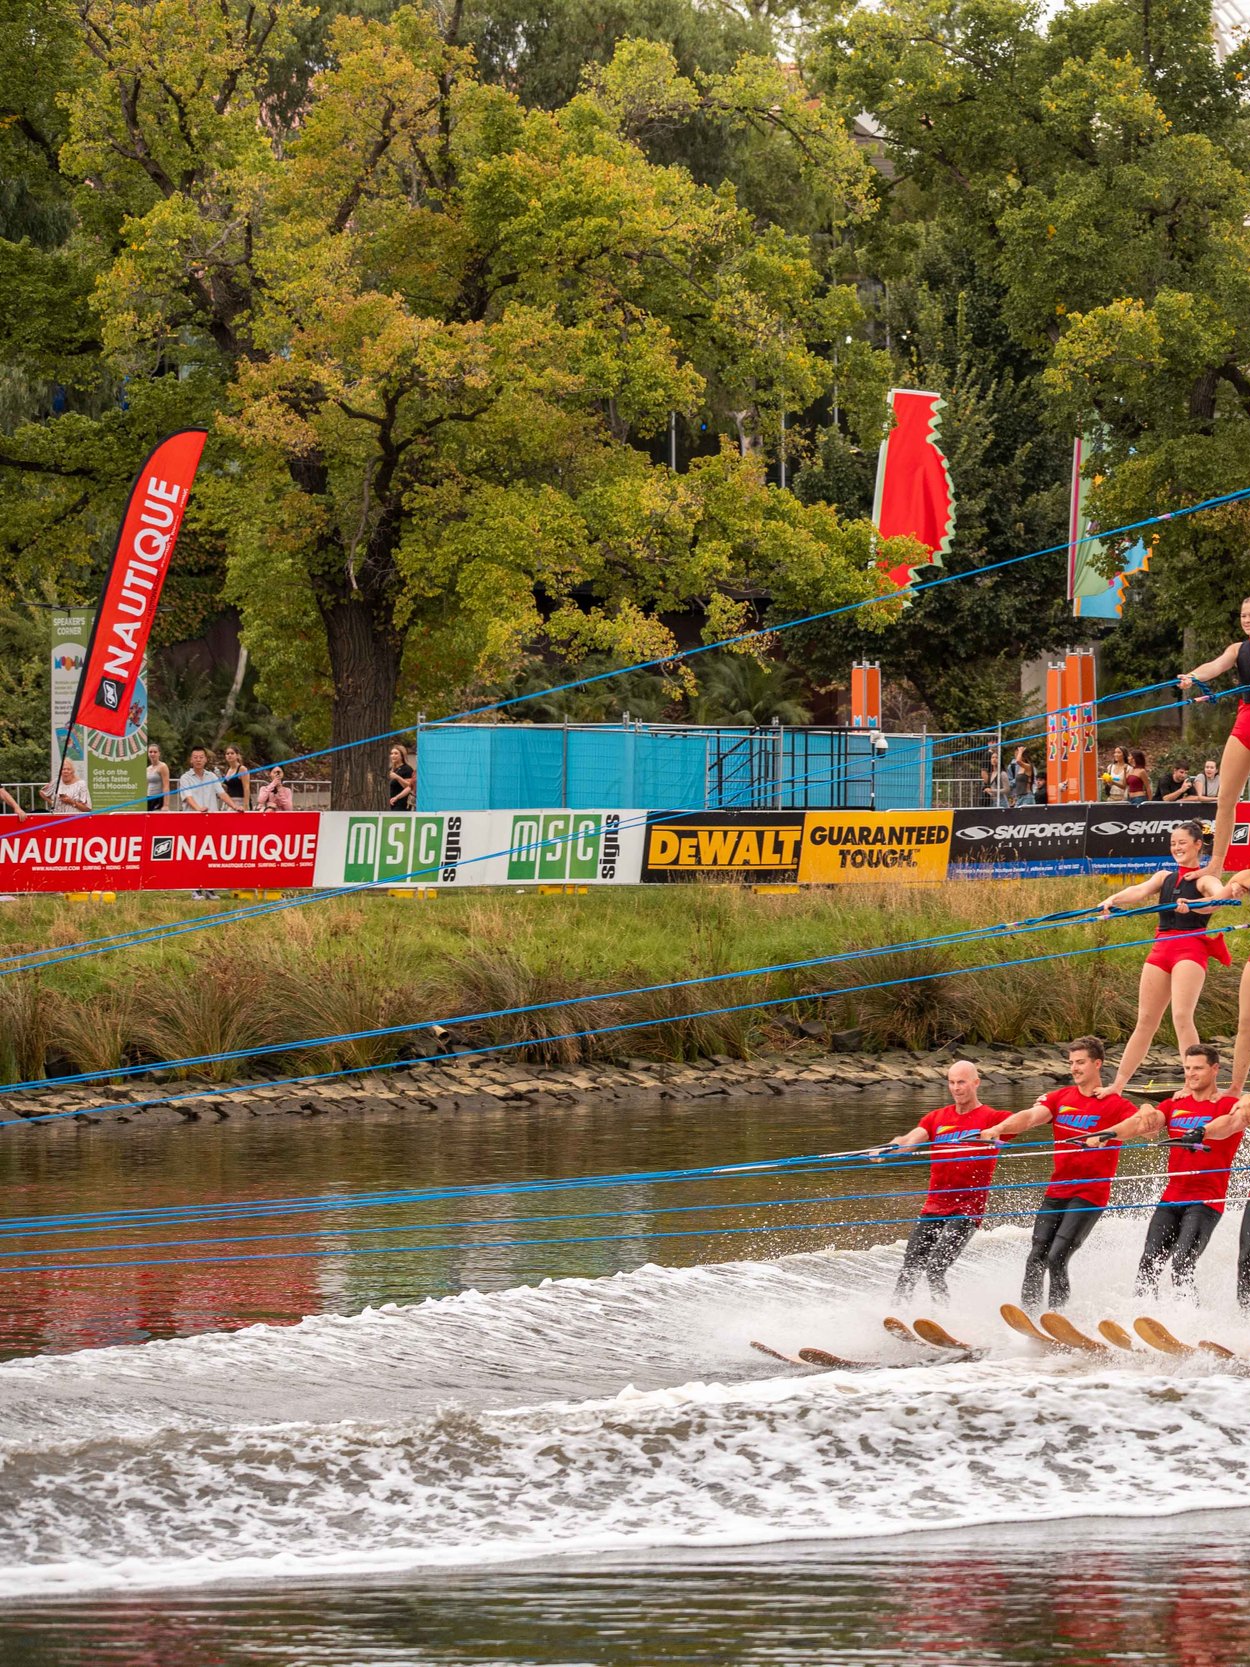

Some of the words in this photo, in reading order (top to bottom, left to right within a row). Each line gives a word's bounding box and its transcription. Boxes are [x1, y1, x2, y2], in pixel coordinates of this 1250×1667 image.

[103, 476, 180, 679] NAUTIQUE
[57, 627, 82, 636] CORNER
[347, 822, 438, 865] MSC
[511, 820, 596, 861] MSC
[599, 814, 620, 879] signs
[810, 826, 949, 846] GUARANTEED
[993, 822, 1086, 839] SKIFORCE
[0, 836, 143, 864] NAUTIQUE
[176, 834, 317, 862] NAUTIQUE
[440, 816, 462, 882] signs
